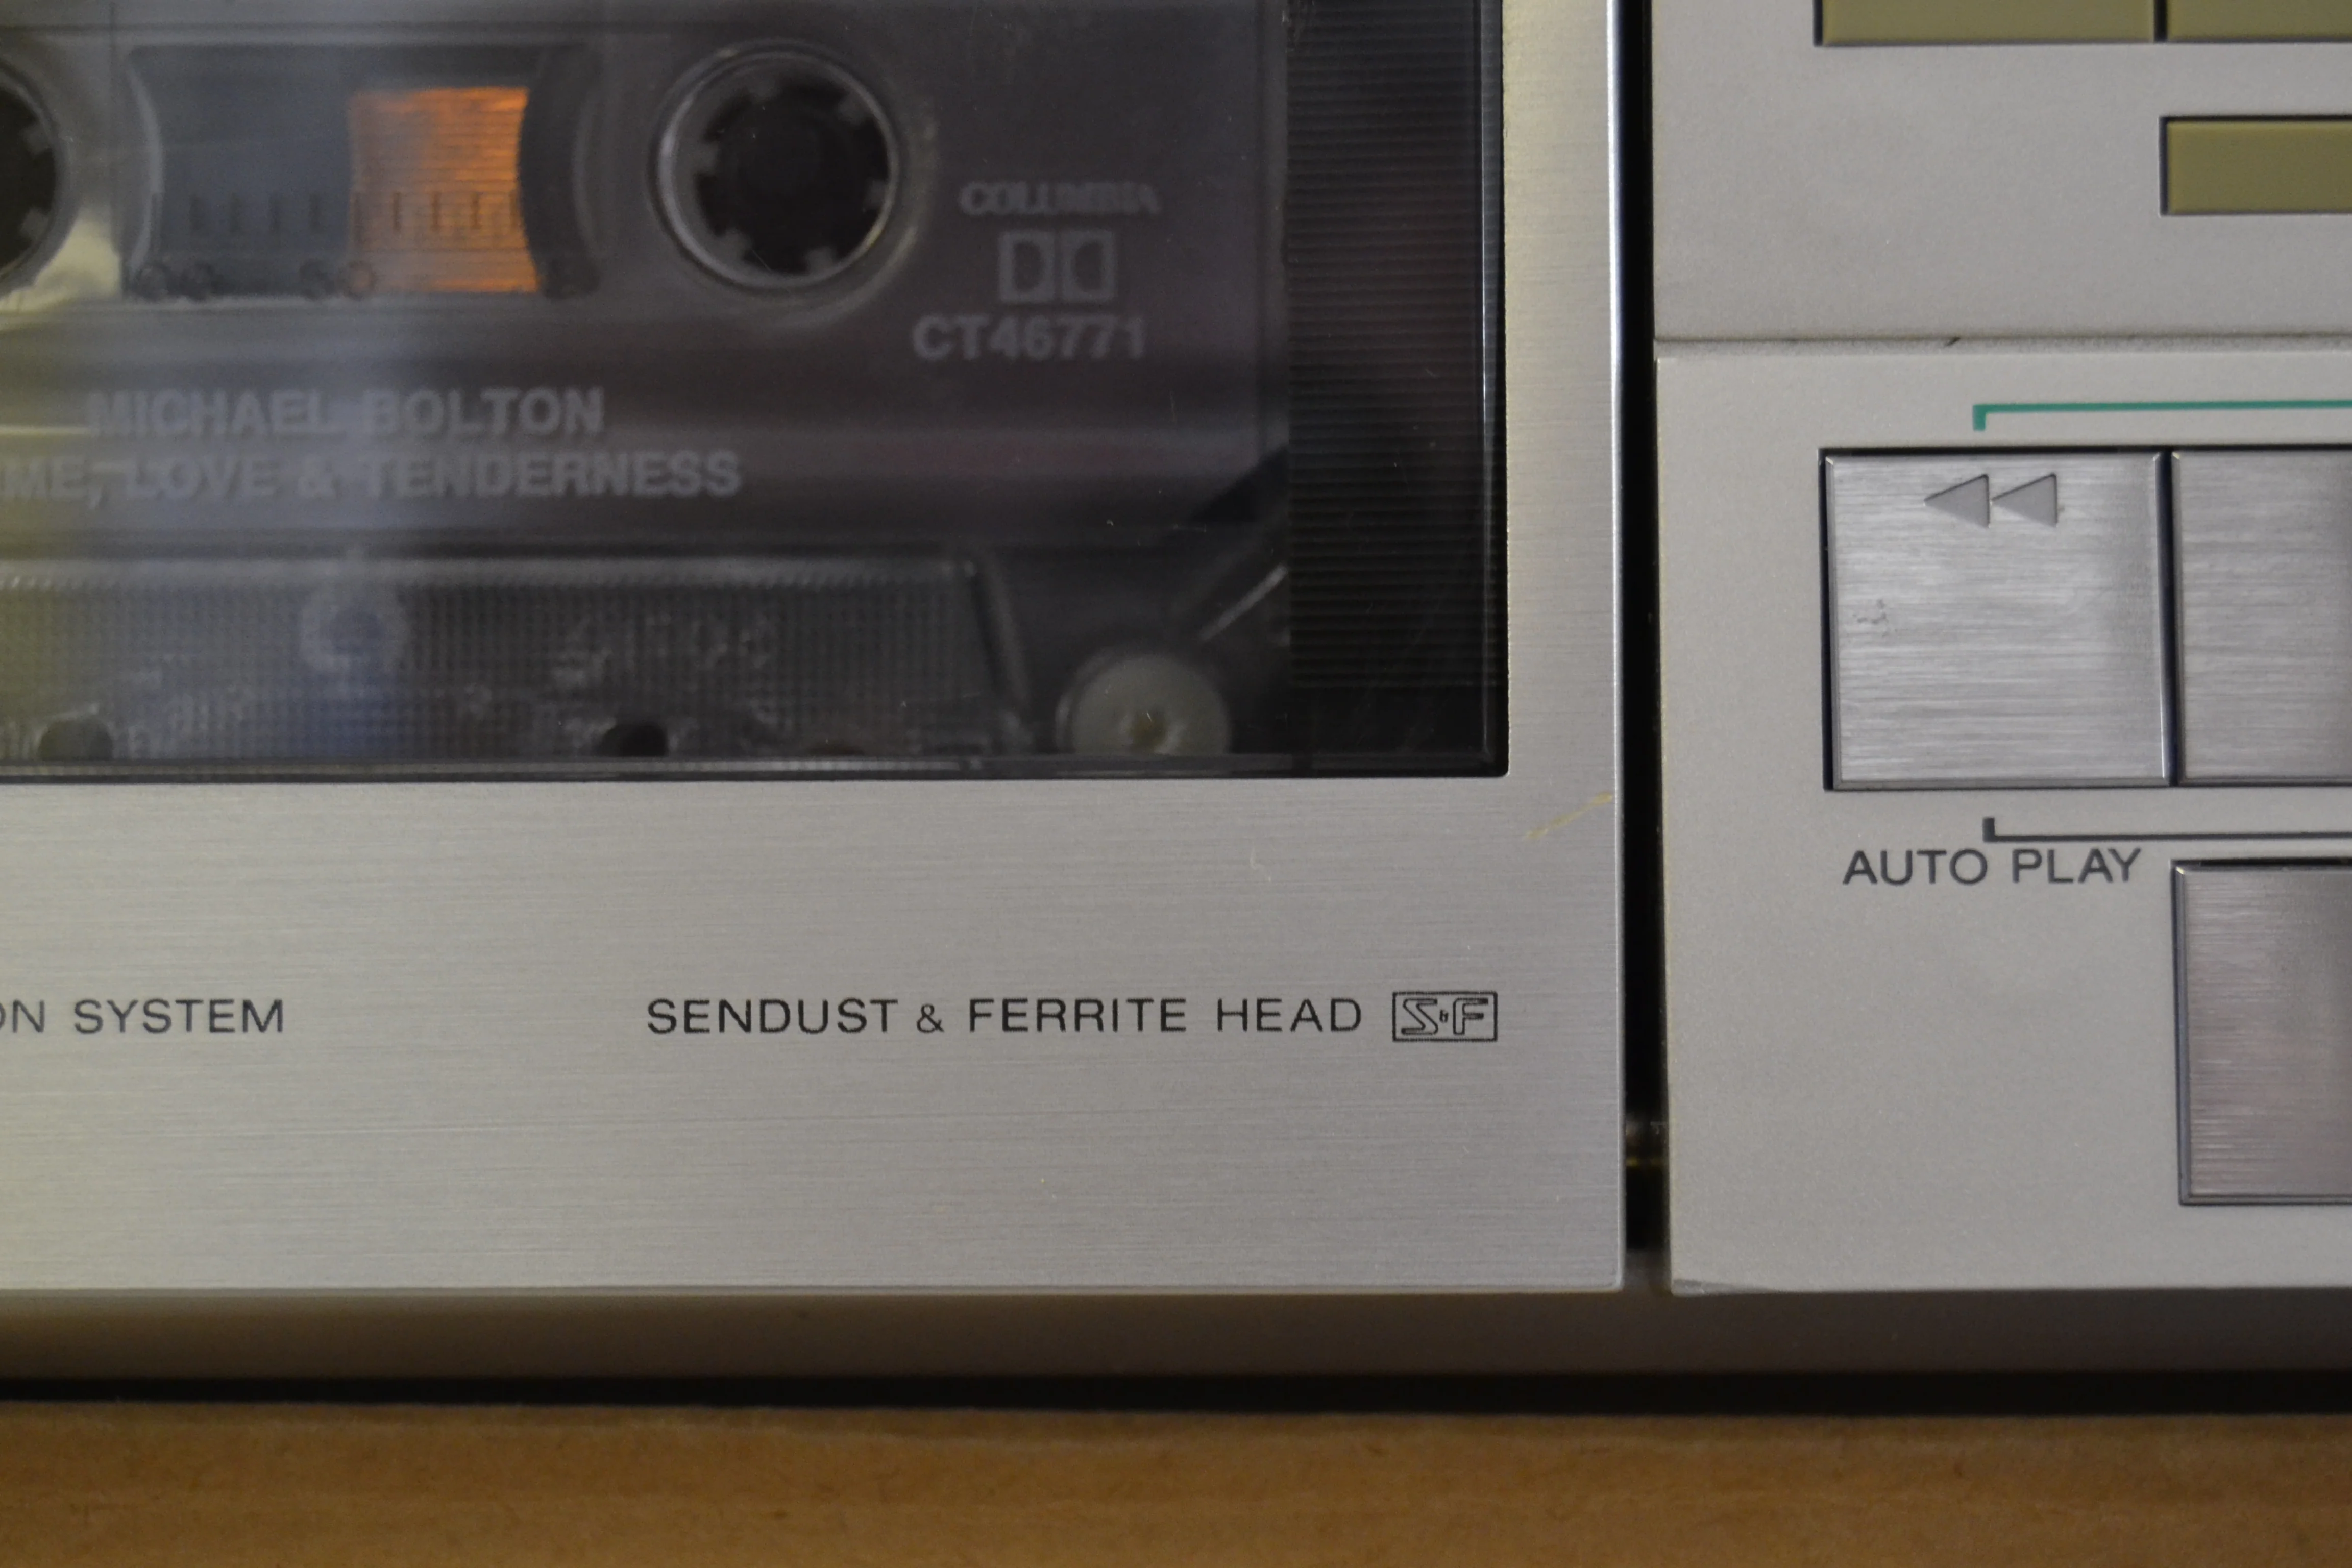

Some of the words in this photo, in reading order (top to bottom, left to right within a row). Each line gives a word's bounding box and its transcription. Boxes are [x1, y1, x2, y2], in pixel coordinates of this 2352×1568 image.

[913, 312, 1147, 361] CT46771
[87, 388, 334, 436] MICHAEL
[362, 386, 606, 435] BOLTON
[125, 453, 279, 499] LOVE
[298, 453, 335, 499] &
[357, 450, 742, 497] TENDERNESS
[1842, 848, 1989, 886] AUTO
[2012, 847, 2142, 884] PLAY
[0, 999, 45, 1034] N
[74, 998, 284, 1034] SYSTEM
[647, 998, 898, 1034] SENDUST
[916, 1003, 945, 1034] &
[969, 997, 1187, 1033] FERRITE
[1217, 998, 1362, 1032] HEAD
